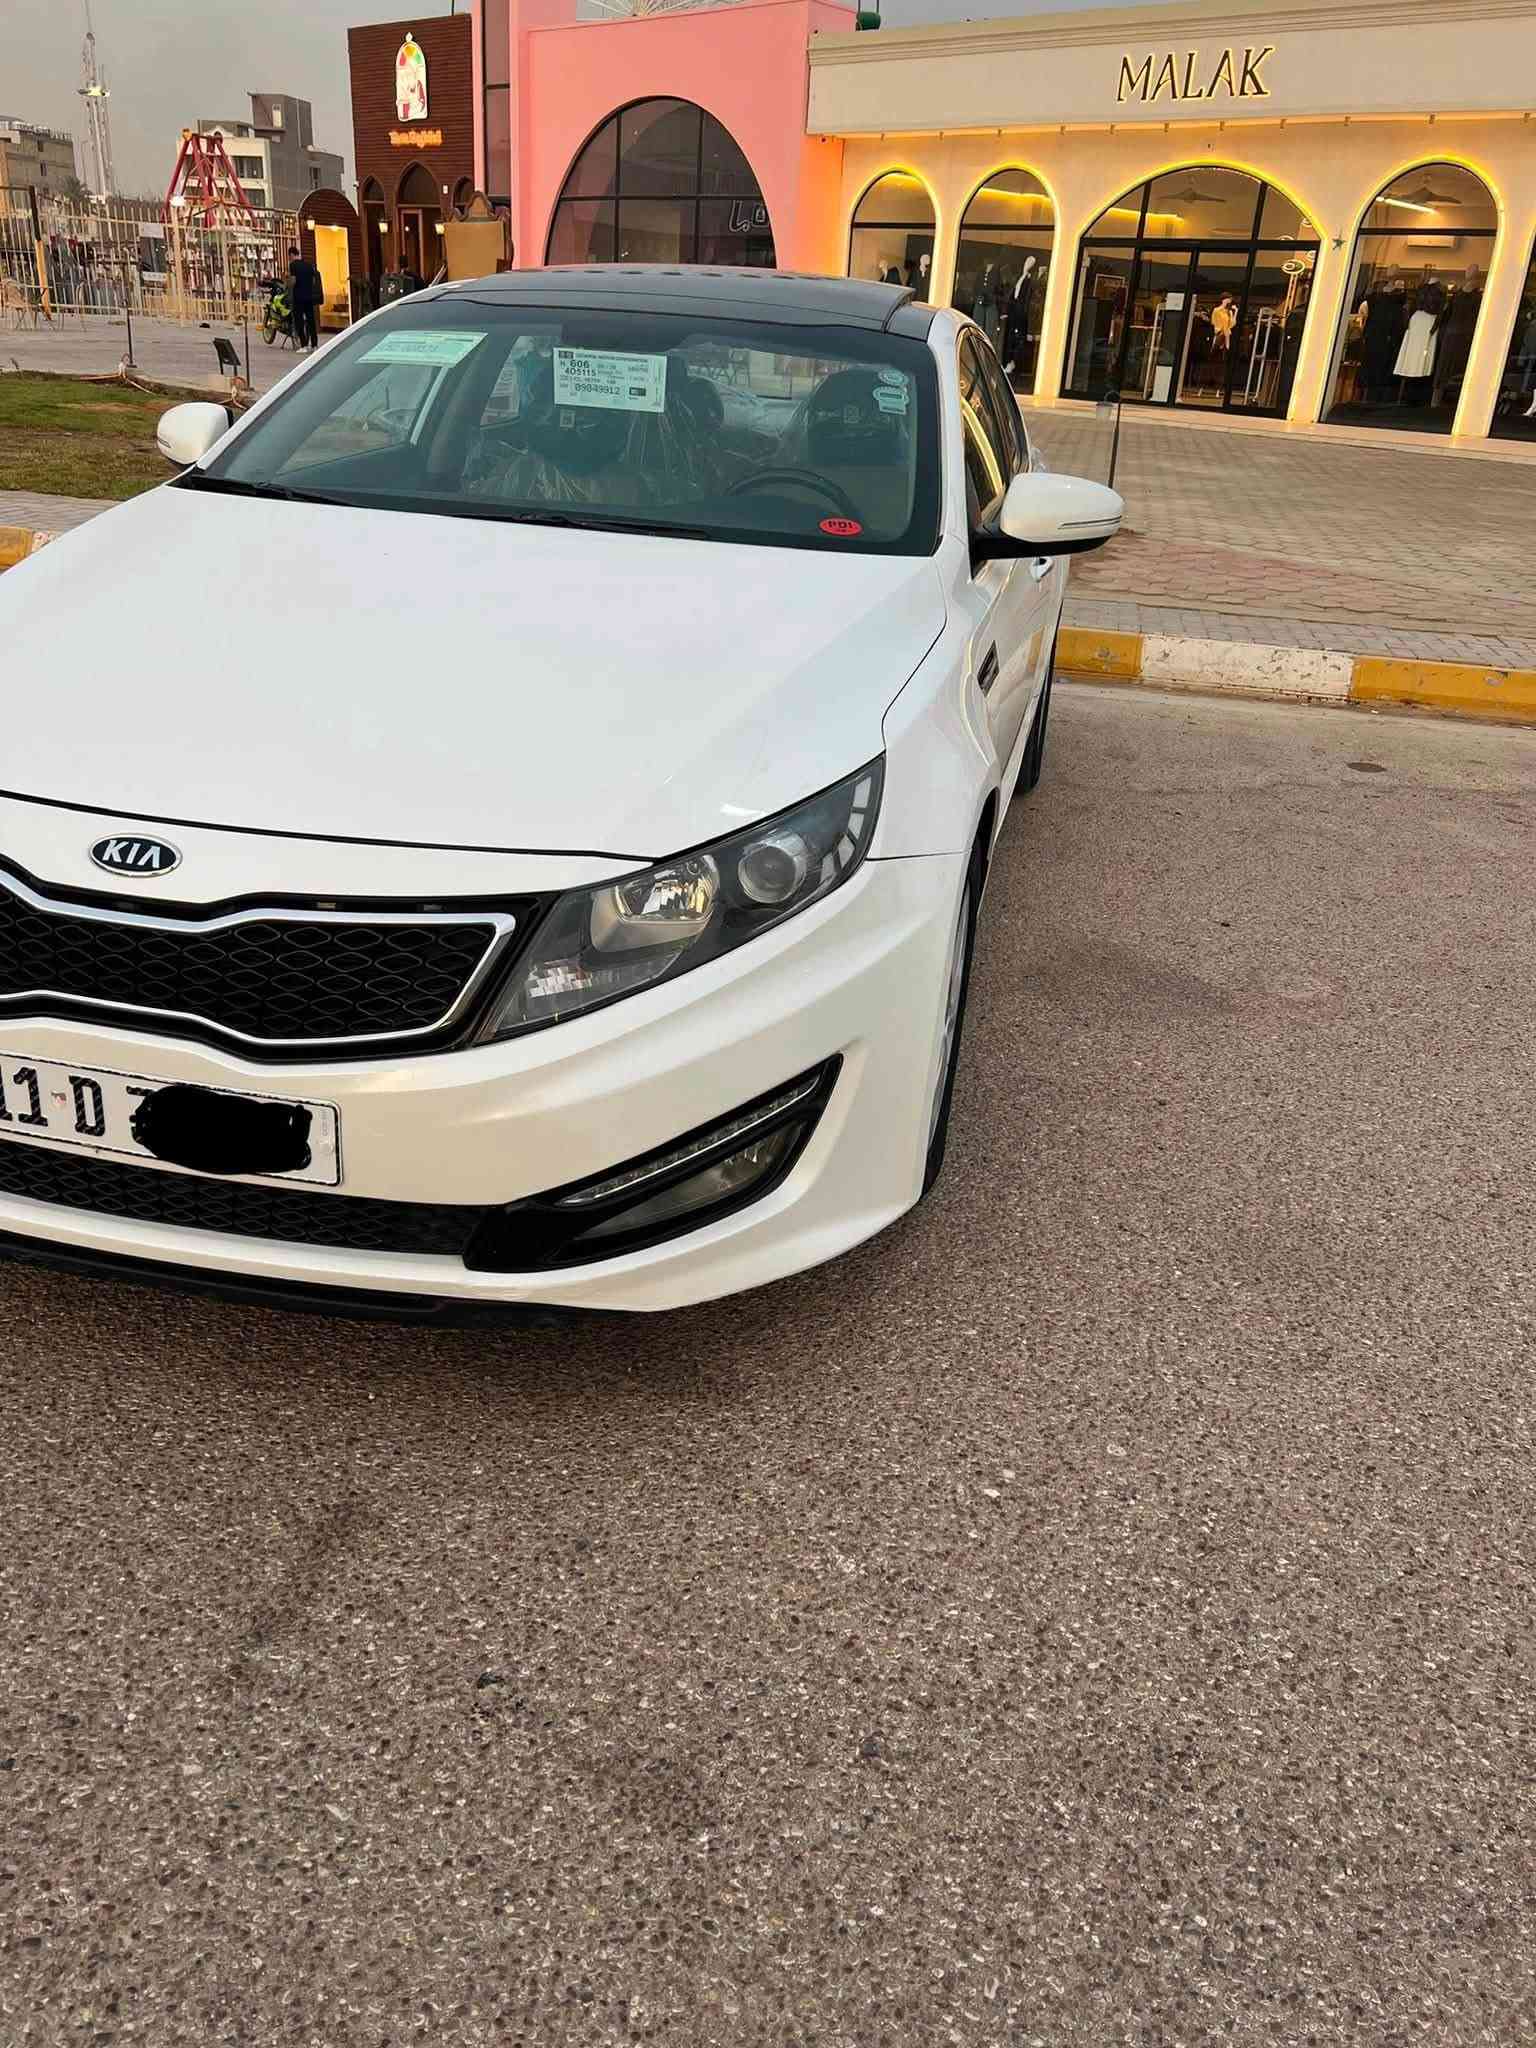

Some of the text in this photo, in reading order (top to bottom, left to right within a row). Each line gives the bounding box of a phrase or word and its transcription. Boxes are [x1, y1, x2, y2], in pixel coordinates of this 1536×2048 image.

[1115, 46, 1274, 102] MALAK
[102, 840, 160, 868] KIA
[68, 1075, 105, 1136] D
